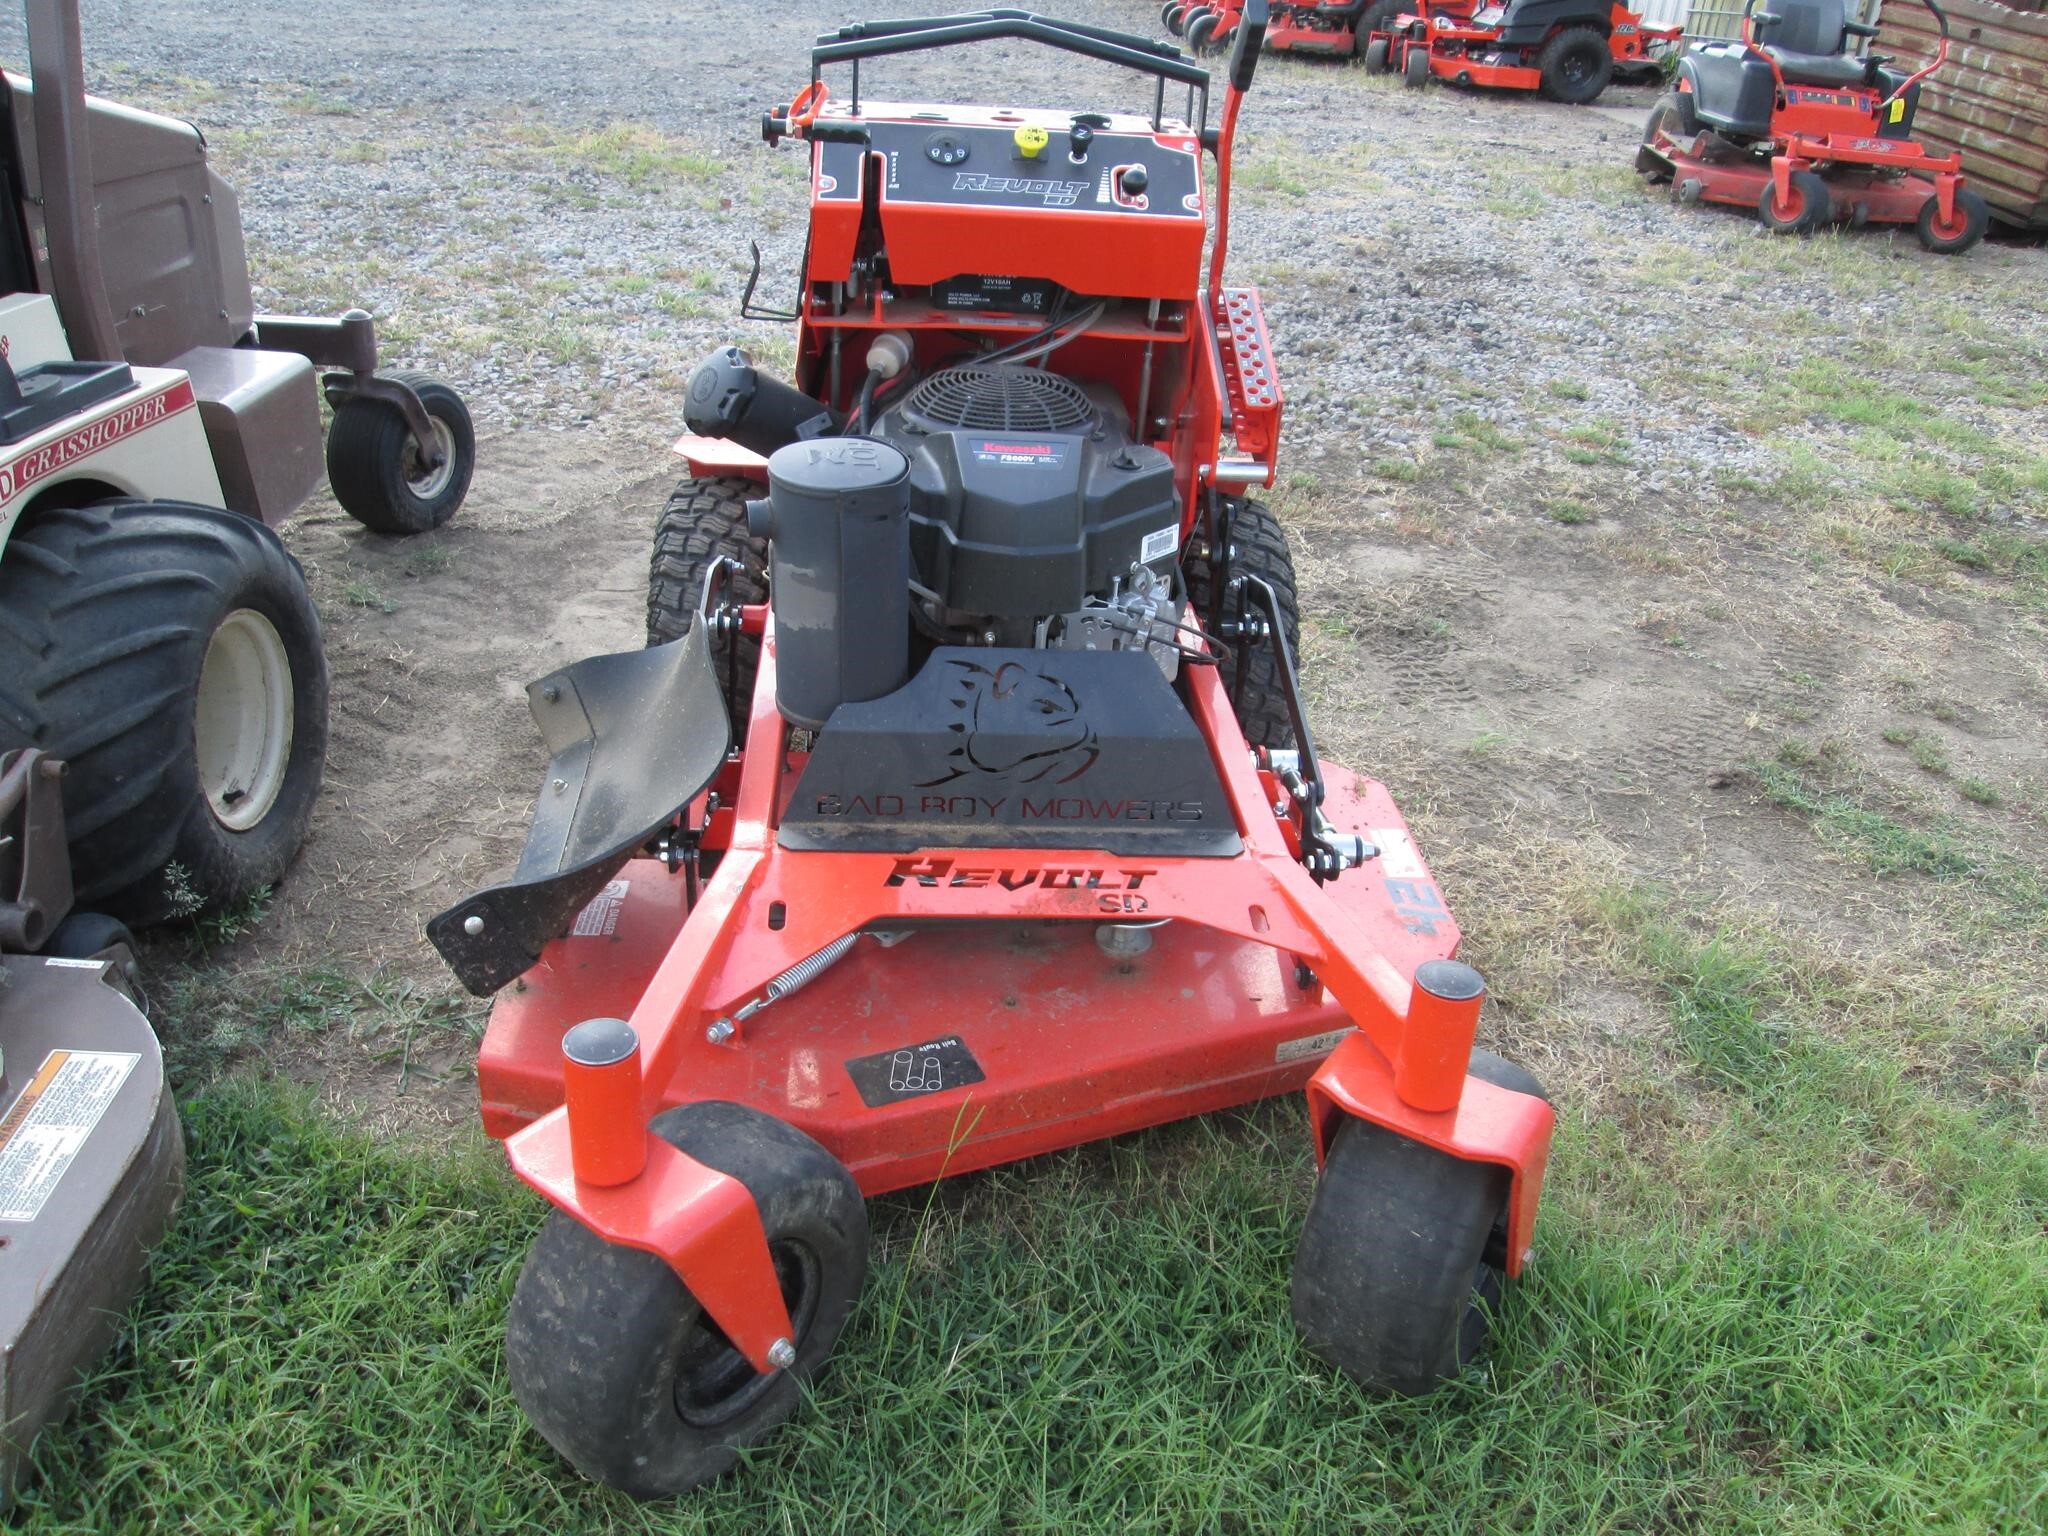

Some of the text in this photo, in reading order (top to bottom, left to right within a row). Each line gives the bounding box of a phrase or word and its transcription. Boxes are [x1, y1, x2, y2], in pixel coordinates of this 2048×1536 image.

[953, 172, 1090, 195] REVOLT
[22, 395, 166, 480] GRASSHOPPER
[984, 443, 1051, 454] Kawasaki
[817, 795, 1201, 821] BAD BOY MOWERS
[883, 857, 1157, 891] REVOLT
[1100, 893, 1148, 913] SD
[919, 1039, 957, 1052] Belt Route
